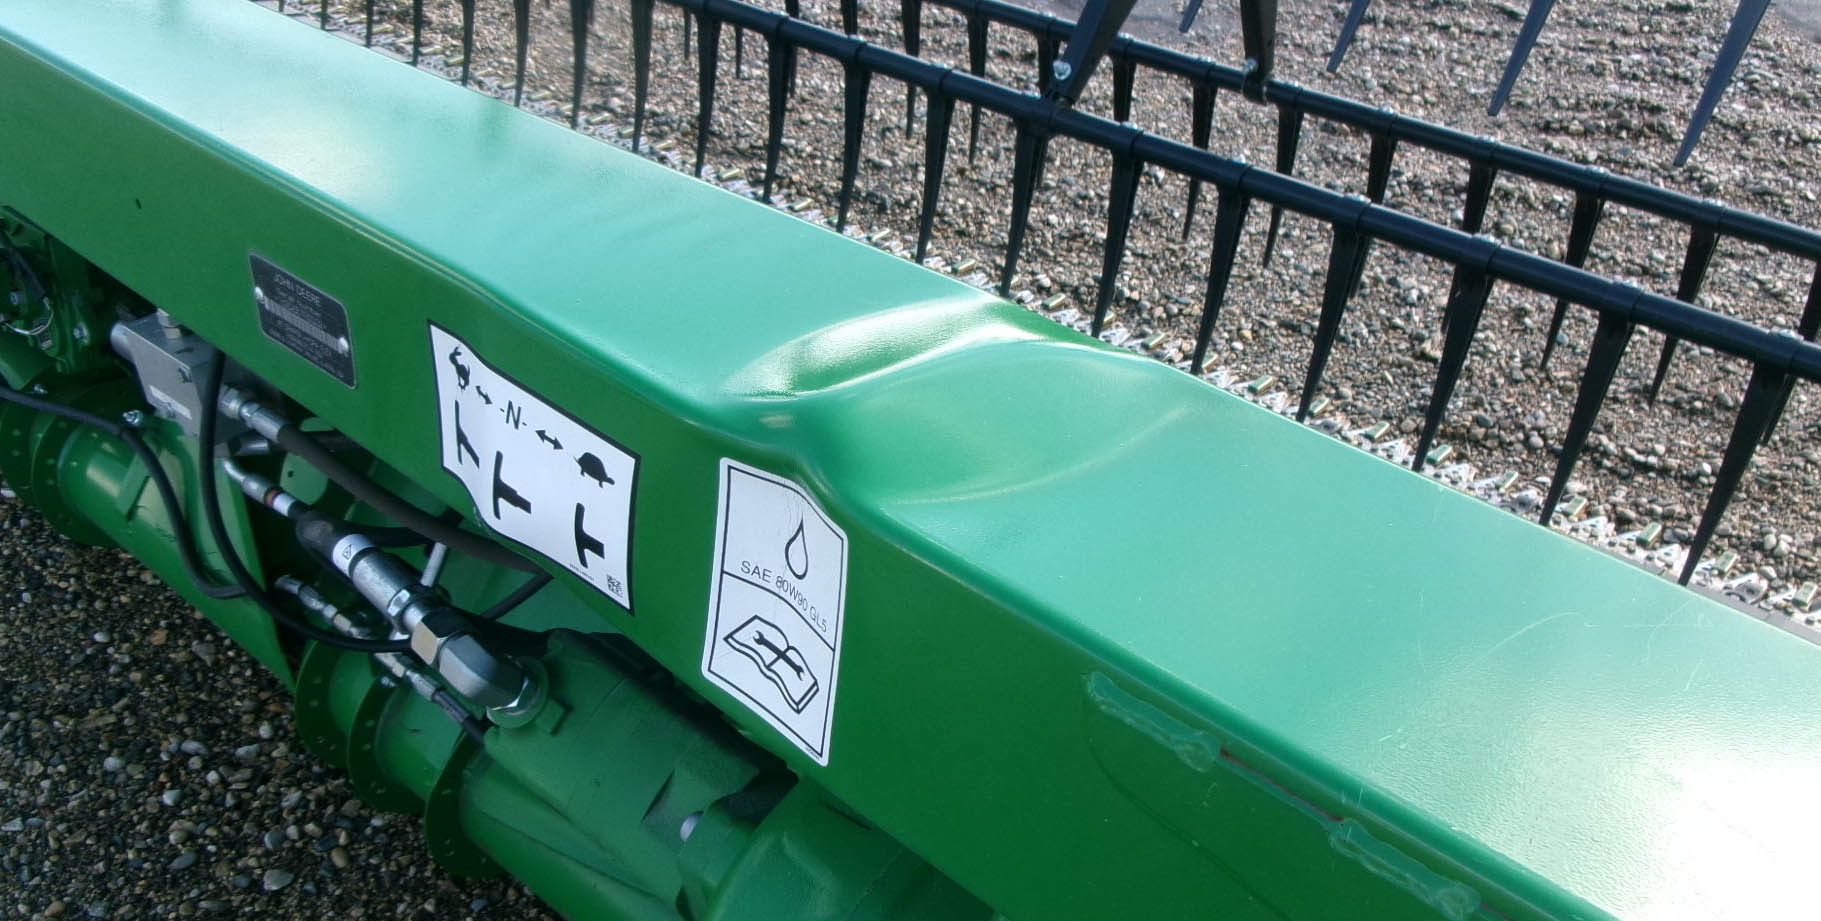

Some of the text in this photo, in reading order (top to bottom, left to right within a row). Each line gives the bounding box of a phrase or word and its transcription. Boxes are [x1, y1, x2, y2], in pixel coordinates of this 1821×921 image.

[740, 560, 827, 633] SAE 80W90 GL5
